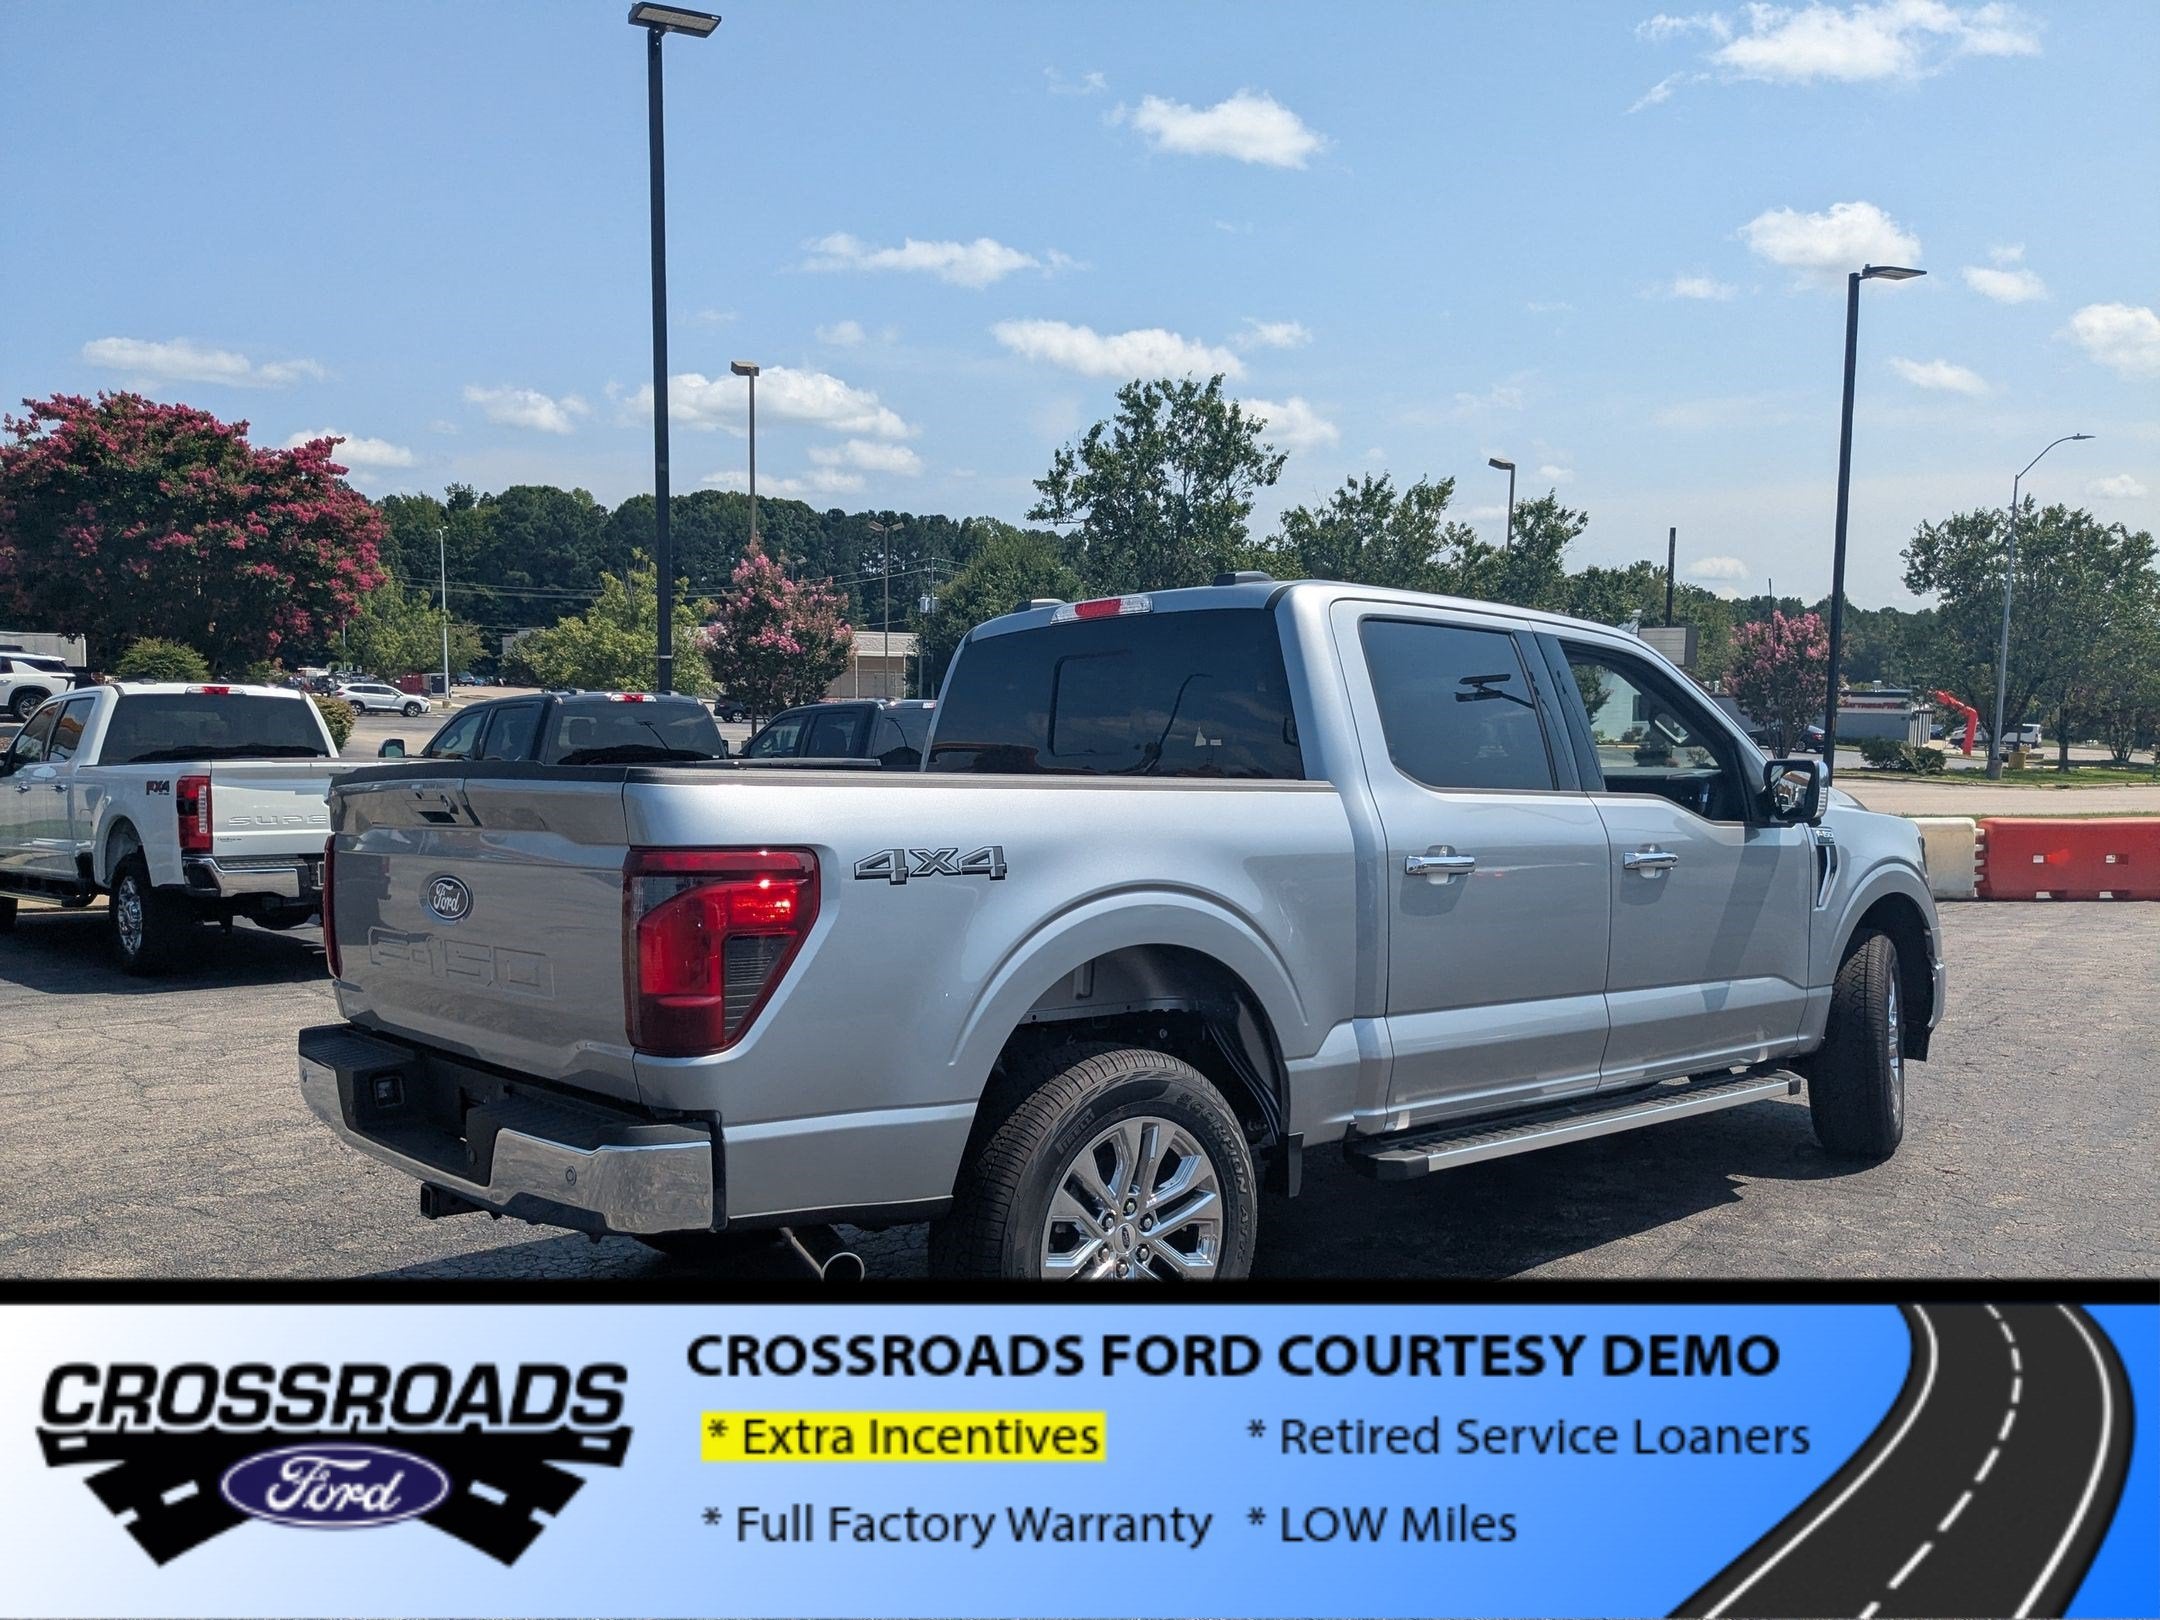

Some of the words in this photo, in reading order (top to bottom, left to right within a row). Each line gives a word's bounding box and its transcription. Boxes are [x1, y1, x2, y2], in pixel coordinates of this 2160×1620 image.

[146, 780, 170, 795] FX4
[229, 814, 327, 826] SUPE
[433, 882, 460, 913] Ford
[368, 926, 556, 999] F-150
